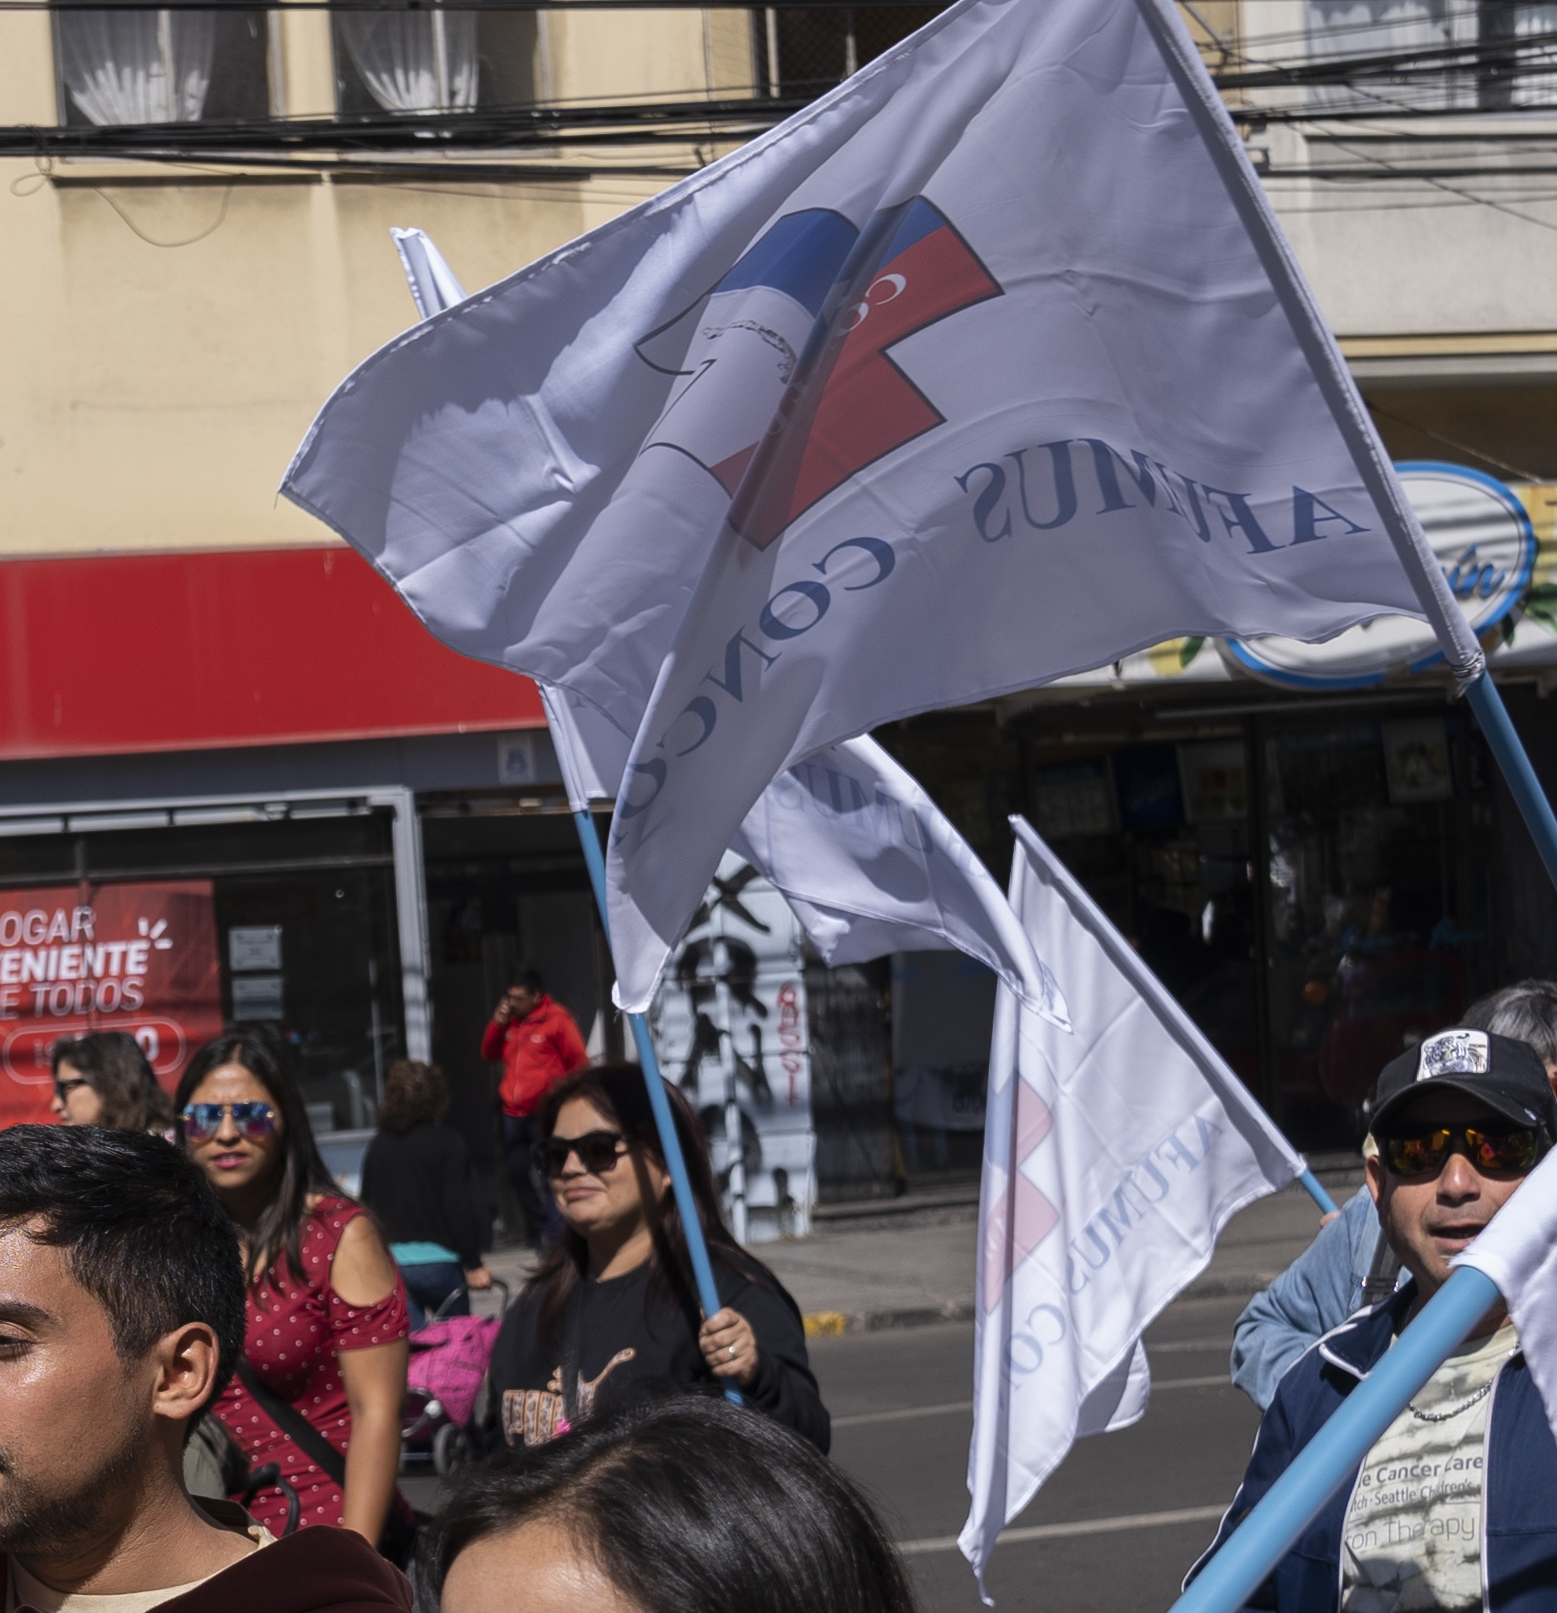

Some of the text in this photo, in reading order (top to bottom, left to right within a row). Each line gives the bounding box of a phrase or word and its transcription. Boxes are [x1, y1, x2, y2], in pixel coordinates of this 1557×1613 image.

[30, 976, 144, 1019] TODOS
[1376, 1463, 1441, 1484] Cancer
[1374, 1486, 1417, 1507] Seattle
[1383, 1516, 1475, 1543] Therapy
